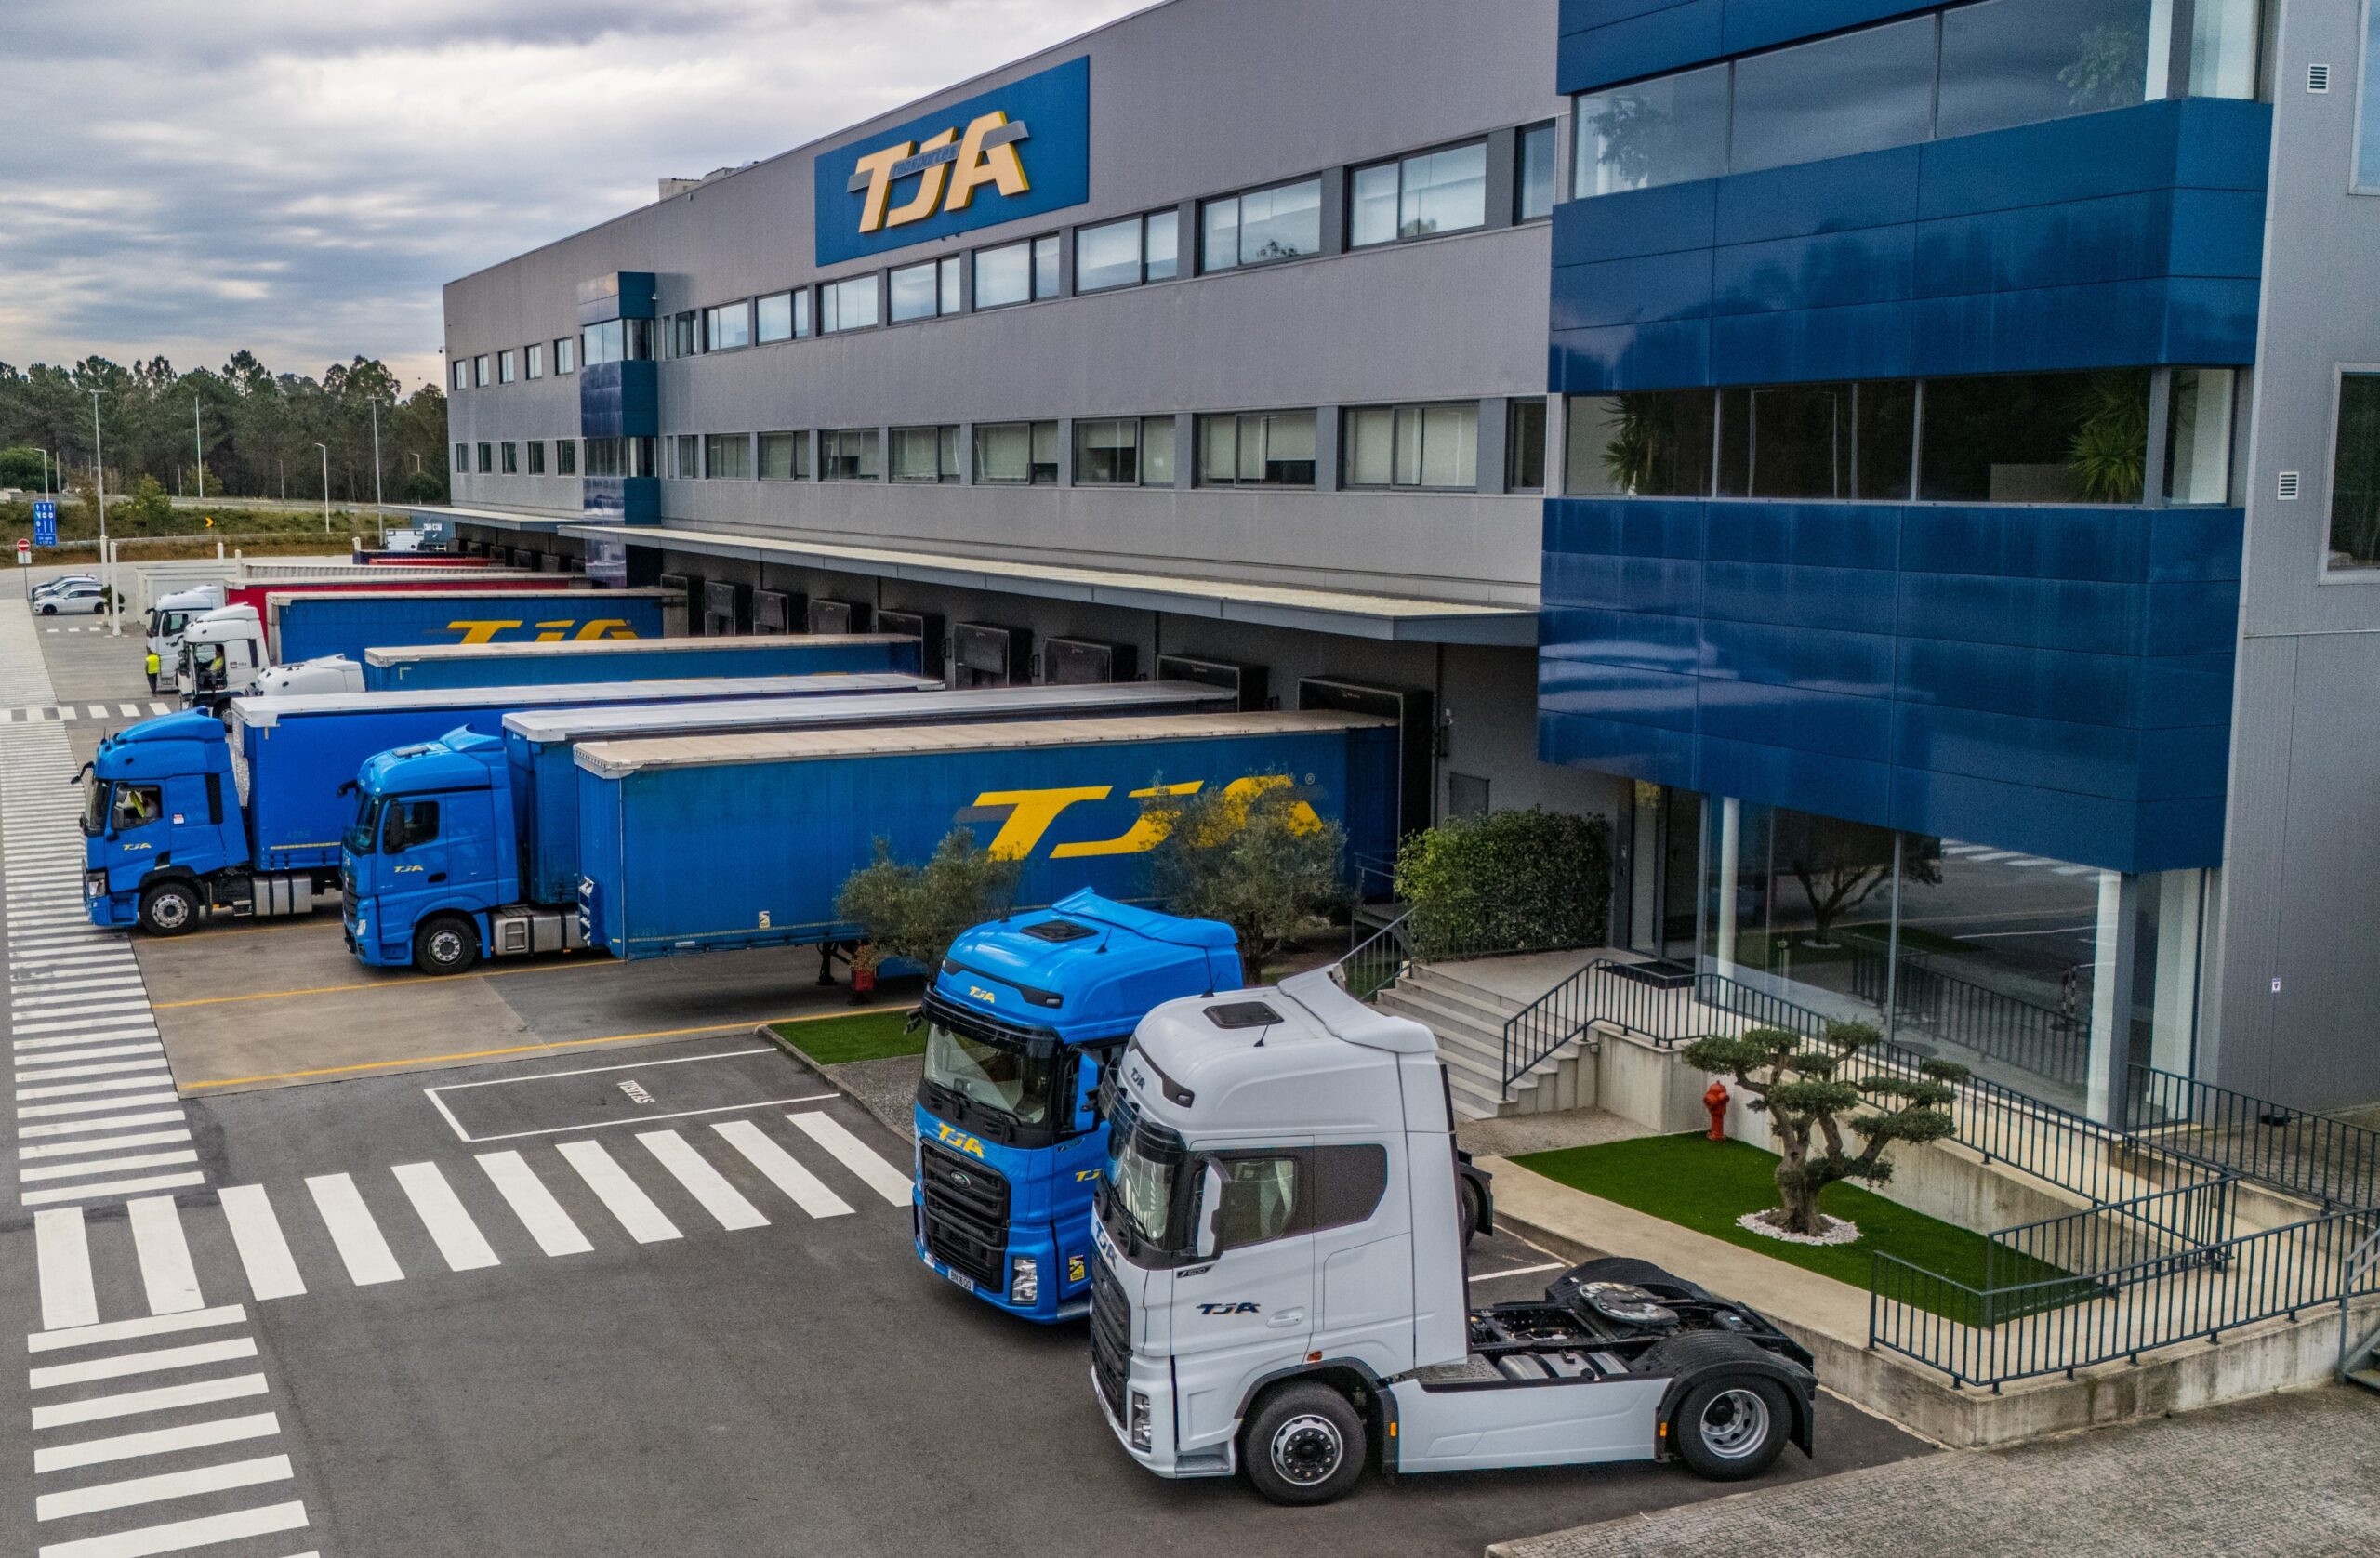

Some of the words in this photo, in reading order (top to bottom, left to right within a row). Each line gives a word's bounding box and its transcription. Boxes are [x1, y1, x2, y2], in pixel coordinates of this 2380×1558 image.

[853, 110, 1030, 233] TJA
[123, 842, 152, 851] TJA
[394, 865, 424, 873] TJA
[969, 985, 995, 1004] TJA
[1130, 1066, 1146, 1090] TJA
[939, 1121, 985, 1159] TJA
[1076, 1168, 1103, 1182] TJ
[1197, 1301, 1261, 1315] TJA
